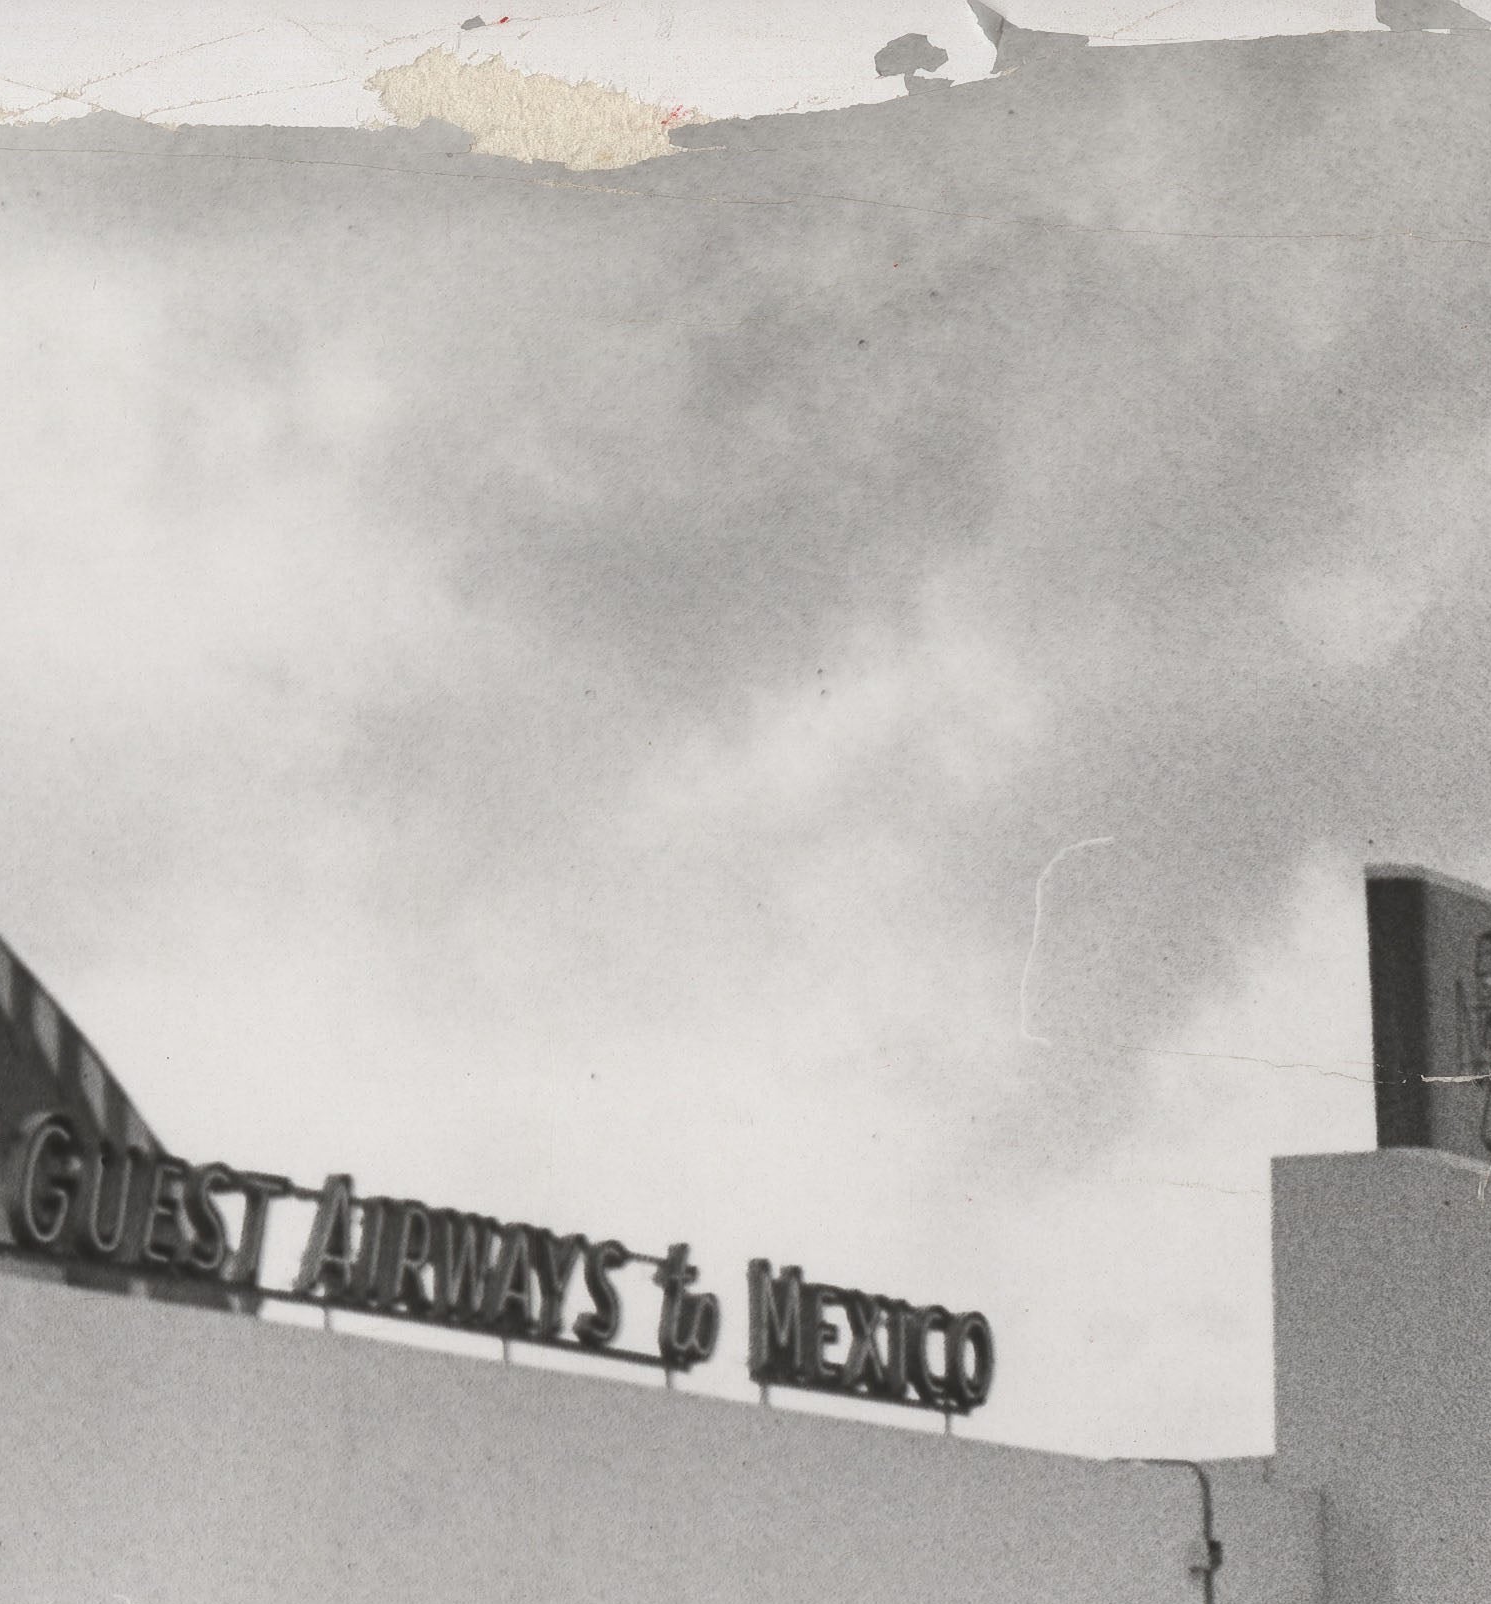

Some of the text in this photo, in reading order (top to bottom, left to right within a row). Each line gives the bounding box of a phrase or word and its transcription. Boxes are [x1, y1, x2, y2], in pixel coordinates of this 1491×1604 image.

[11, 1112, 291, 1290] GUEST
[294, 1173, 621, 1346] AIRWAYS
[654, 1243, 719, 1368] to
[747, 1258, 994, 1412] MEXICO
